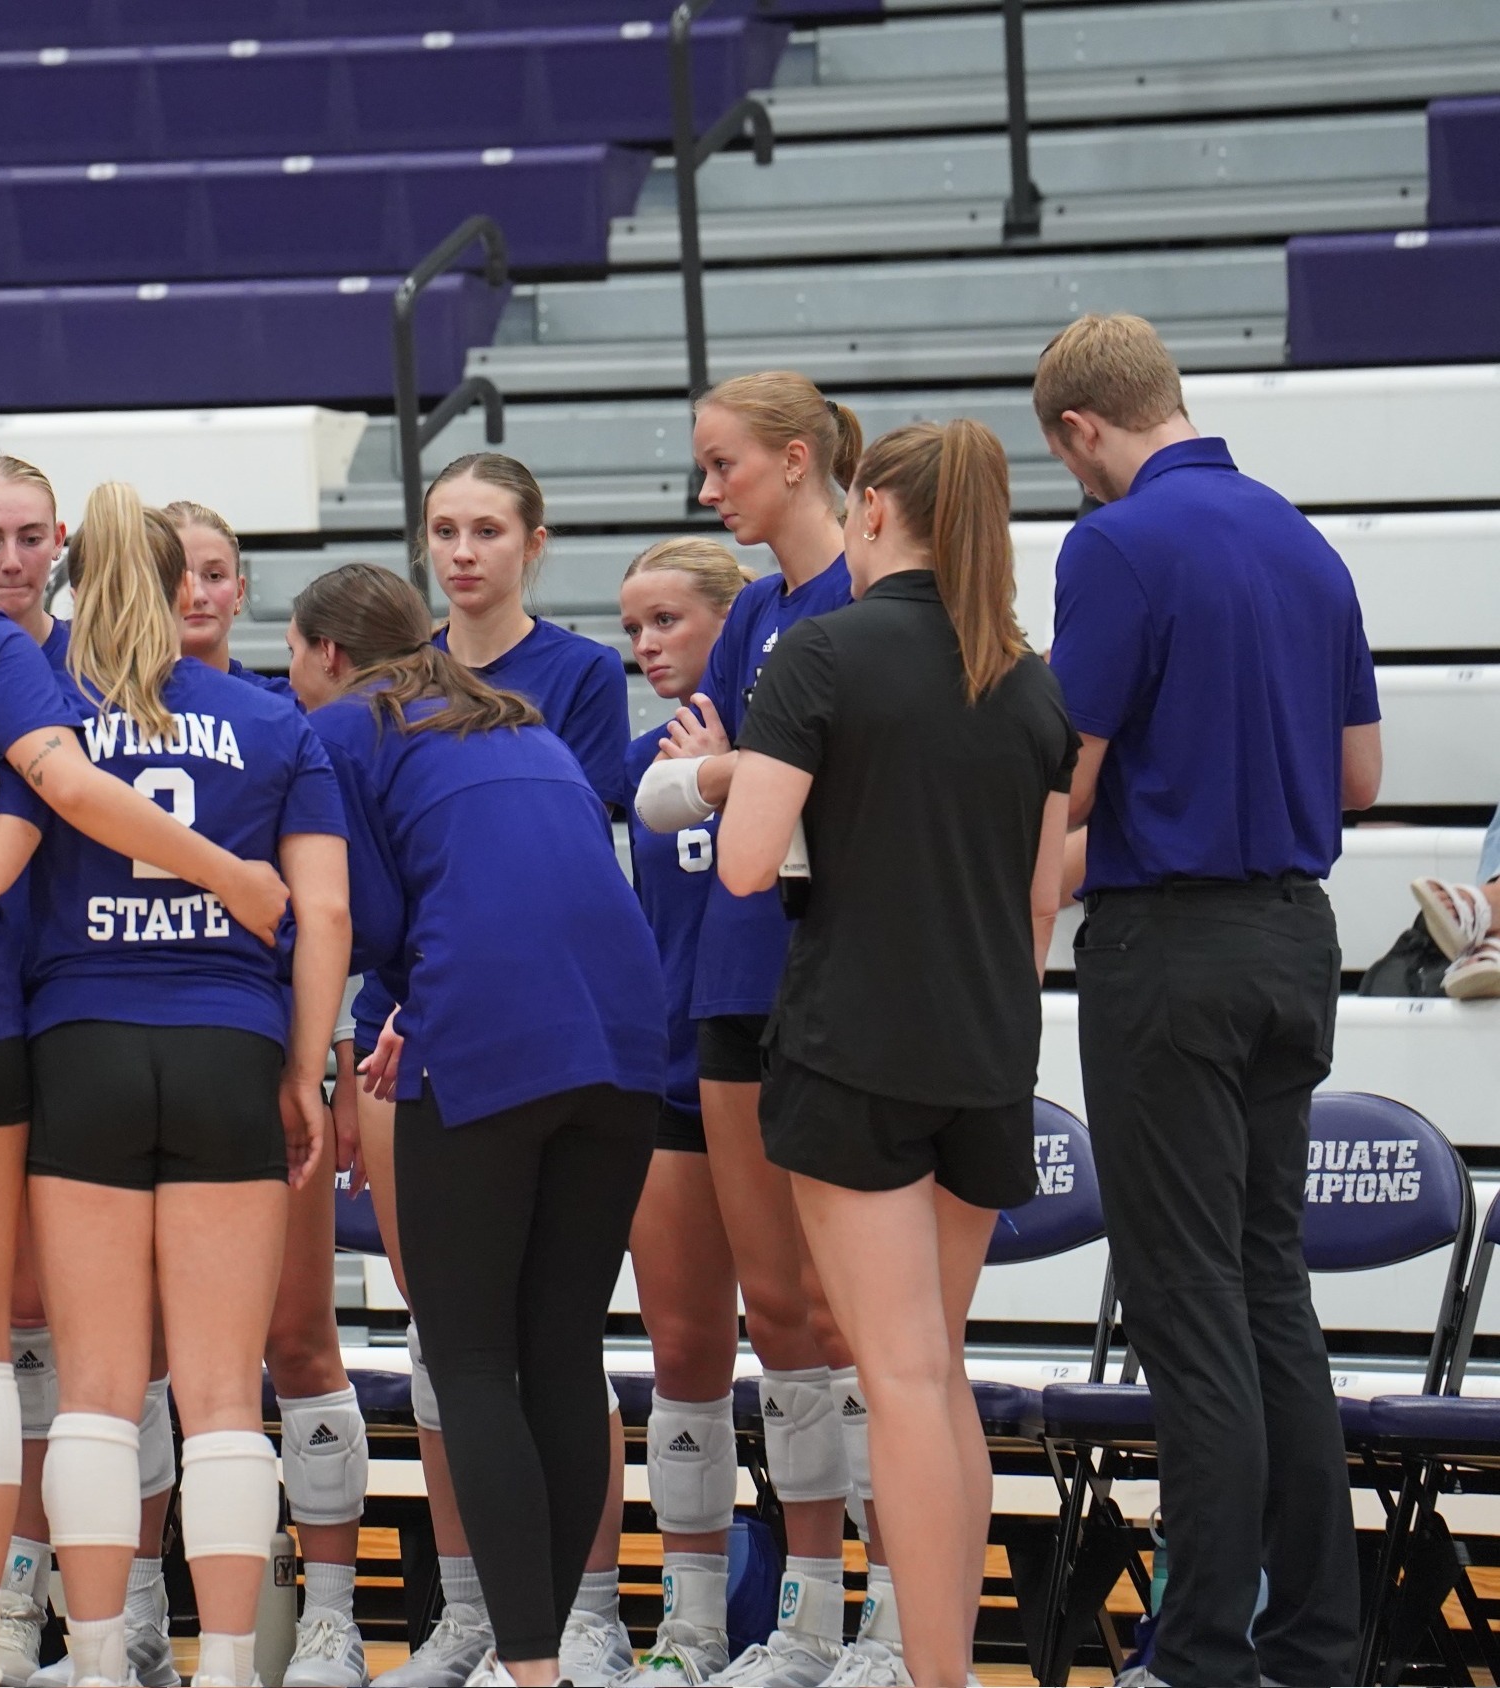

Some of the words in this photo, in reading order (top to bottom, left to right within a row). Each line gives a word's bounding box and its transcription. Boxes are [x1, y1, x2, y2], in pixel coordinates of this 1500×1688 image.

[87, 893, 231, 942] STATE
[15, 1361, 45, 1370] adidas
[1052, 1367, 1069, 1379] 12
[1332, 1376, 1348, 1388] 13
[309, 1434, 339, 1446] adidas
[669, 1443, 700, 1453] adidas
